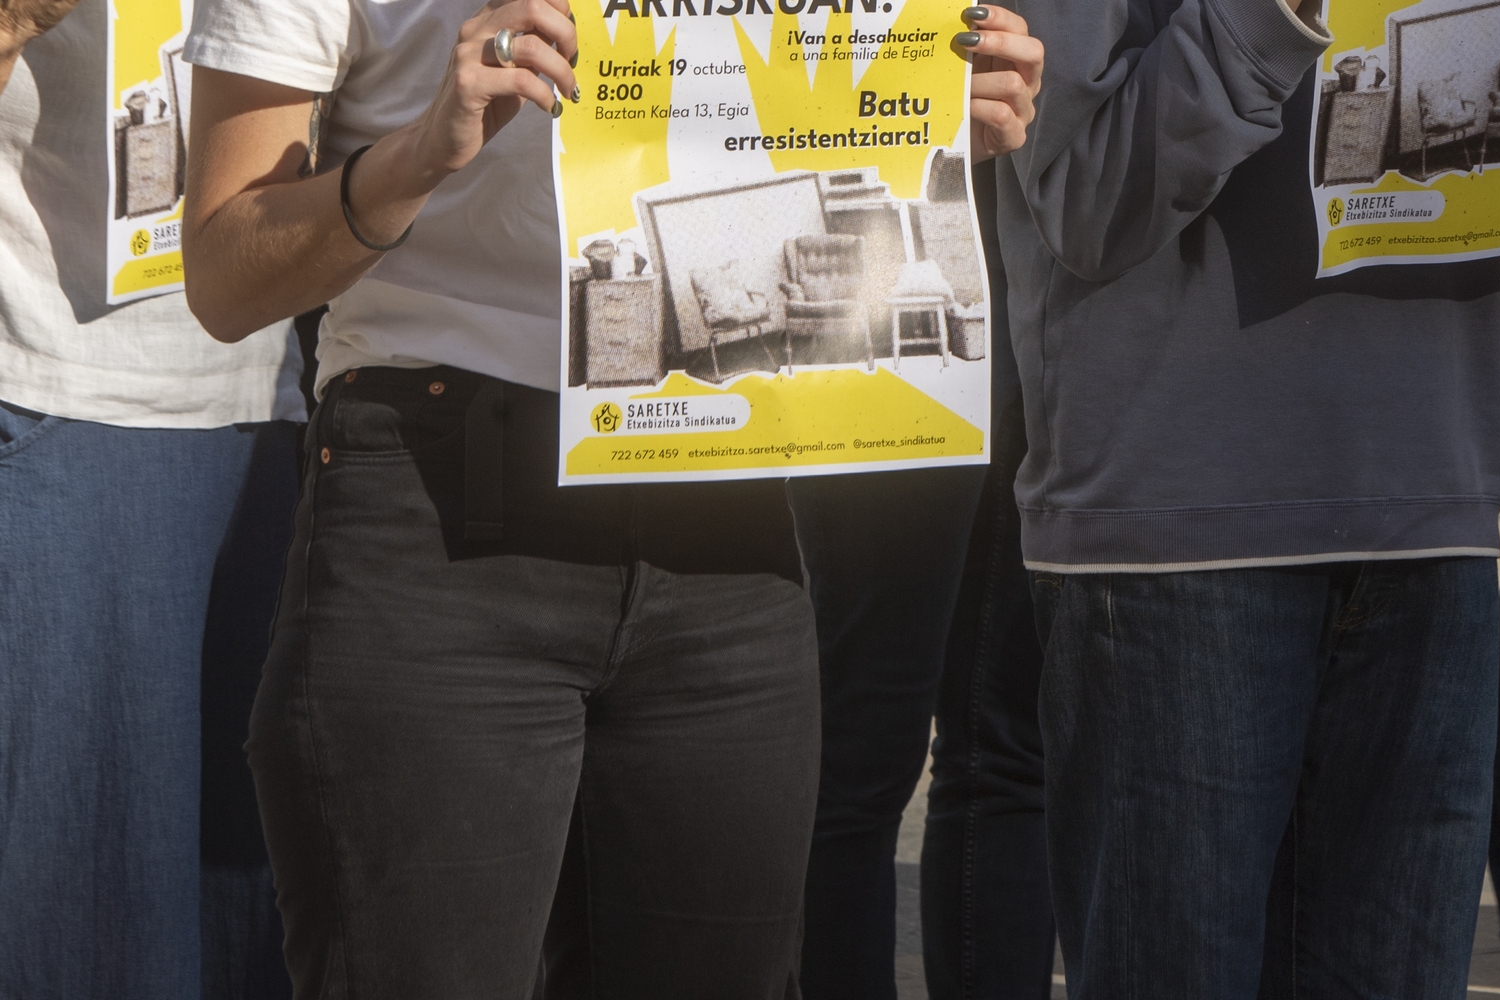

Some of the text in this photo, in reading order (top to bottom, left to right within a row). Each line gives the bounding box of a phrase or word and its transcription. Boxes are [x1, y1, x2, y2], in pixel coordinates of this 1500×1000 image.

[832, 35, 842, 44] a
[848, 28, 938, 44] desahuciar
[790, 45, 934, 61] a una familia de Egia!
[599, 59, 746, 77] Urriak 19 octubre
[597, 84, 643, 101] 8:00
[596, 103, 748, 120] Baztan Kalea 13, Egia
[859, 91, 929, 117] Batu
[725, 122, 928, 151] erresistentziara!
[1348, 196, 1395, 210] SARETXE
[1346, 209, 1432, 221] Etxebizitza Sindikatua
[628, 402, 687, 417] SARETXE
[628, 416, 735, 429] Etxebizitza Sindikatua
[612, 435, 945, 460] 722 672 459 etxebizitza.saretxe@gmail.com @saretxe_sindikatua
